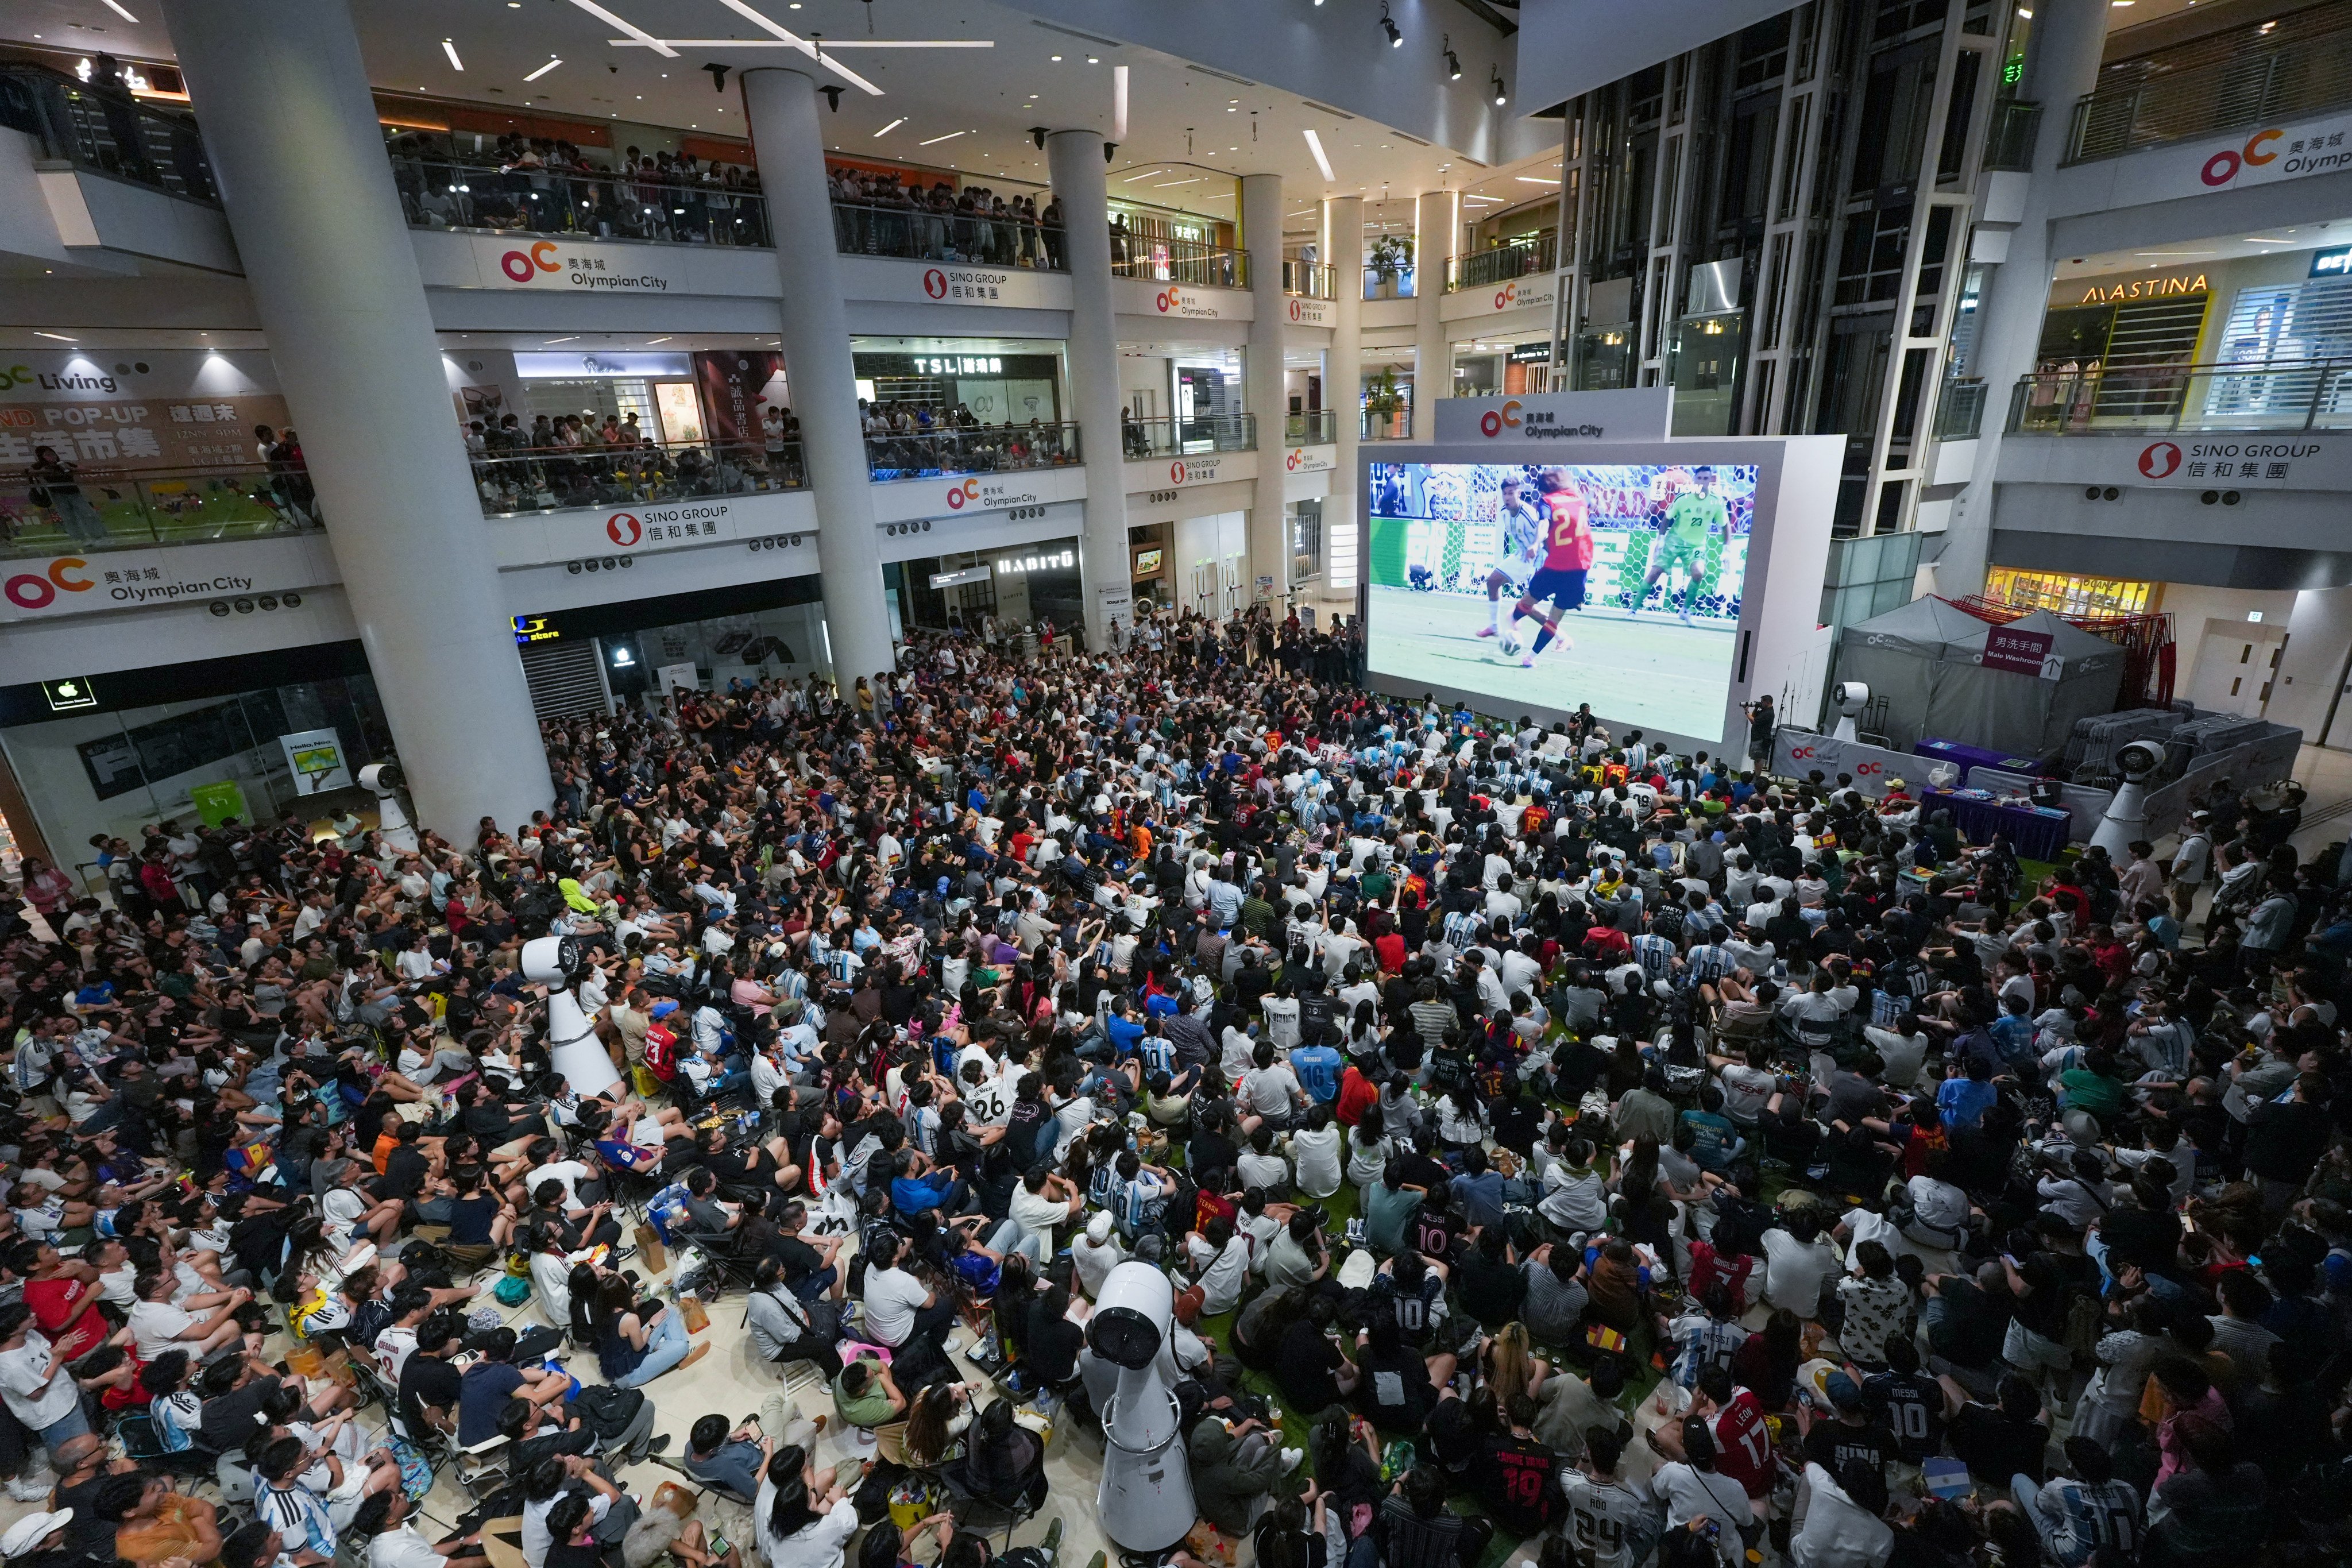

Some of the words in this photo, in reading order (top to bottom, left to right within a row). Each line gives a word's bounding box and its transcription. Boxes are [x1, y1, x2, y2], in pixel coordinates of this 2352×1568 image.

[2288, 132, 2345, 155] 奧海城
[2201, 129, 2284, 186] OC
[2284, 152, 2352, 173] Olymp
[501, 241, 562, 283] OC
[568, 258, 605, 271] 奧海城
[571, 273, 640, 289] Olympian
[641, 276, 667, 291] City
[950, 273, 972, 282] SINO
[975, 274, 1006, 284] GROUP
[952, 285, 998, 299] 信和集團
[1494, 283, 1515, 309] OC
[1517, 288, 1532, 296] 奧海城
[2083, 275, 2207, 302] MASTINA
[1157, 287, 1179, 312] OC
[1517, 296, 1543, 307] Olympian
[1543, 293, 1554, 303] City
[1182, 307, 1207, 316] Olympian
[1207, 308, 1218, 318] City
[1301, 312, 1322, 322] 信和集團
[914, 359, 956, 373] TSL
[38, 373, 117, 393] Living
[44, 407, 148, 426] POP-UP
[730, 384, 750, 438] 誠品書店
[1481, 400, 1522, 438] OC
[1525, 412, 1554, 424] 奧海城
[216, 428, 242, 437] 9PM
[1525, 425, 1578, 438] Olympian
[1579, 424, 1603, 438] City
[2191, 445, 2241, 457] SINO
[2245, 445, 2320, 457] GROUP
[1186, 461, 1200, 469] SINO
[1201, 459, 1221, 468] GROUP
[1287, 448, 1301, 471] OC
[1303, 462, 1319, 470] Olympian
[1187, 469, 1215, 481] 信和集團
[2188, 461, 2289, 478] 信和集團
[947, 478, 980, 509] OC
[983, 486, 1003, 495] 奧海城
[1674, 483, 1701, 495] now
[984, 495, 1021, 507] Olympian
[1022, 493, 1037, 504] City
[646, 511, 679, 523] SINO
[682, 507, 728, 519] GROUP
[1691, 517, 1702, 527] 23
[648, 521, 717, 540] 信和集團
[999, 551, 1072, 573] HABITŪ
[5, 558, 95, 609] OC
[105, 567, 161, 584] 奧海城
[111, 582, 211, 601] Olympian
[213, 576, 253, 592] City
[530, 631, 559, 641] store
[1867, 634, 1884, 645] OC
[1995, 636, 2043, 654] 男洗手間
[1987, 651, 2004, 659] Male
[2005, 653, 2043, 666] Washroom
[1266, 737, 1278, 751] 19
[1791, 746, 1816, 759] OC
[1611, 768, 1625, 783] 19
[1857, 762, 1882, 775] OC
[1180, 806, 1185, 816] 9
[1528, 816, 1540, 832] 19
[1930, 844, 1938, 860] 5
[1662, 905, 1682, 914] TOKYO
[1447, 927, 1463, 947] 10
[1642, 948, 1662, 970] 10
[829, 961, 843, 980] 10
[1702, 960, 1721, 979] 10
[1906, 964, 1920, 972] MESSI
[1906, 971, 1928, 997] 10
[1143, 1049, 1159, 1069] 10
[1303, 1065, 1324, 1087] 16
[973, 1086, 992, 1098] HEAVEN
[1485, 1078, 1503, 1096] 19
[1731, 1080, 1766, 1095] SCENE
[975, 1091, 1005, 1124] 26
[1687, 1121, 1724, 1134] TRAVELLING
[1114, 1179, 1128, 1194] MESSI
[1113, 1189, 1127, 1219] 10
[1198, 1198, 1219, 1214] FERRAN
[1422, 1212, 1445, 1223] MESSI
[1418, 1224, 1447, 1254] 10
[1713, 1256, 1739, 1272] RONALDO
[1716, 1270, 1732, 1286] 7
[64, 1279, 80, 1300] CHICAGO
[1393, 1296, 1423, 1331] 10
[1704, 1331, 1729, 1345] MESSI
[1697, 1344, 1735, 1373] 10
[1892, 1388, 1918, 1399] MESSI
[1736, 1407, 1754, 1427] LEON
[1887, 1401, 1928, 1438] 10
[1739, 1416, 1770, 1470] 17
[1496, 1451, 1524, 1467] LAMINE
[1525, 1454, 1550, 1469] YAMAL
[1502, 1467, 1542, 1508] 19
[2082, 1487, 2116, 1500] MESSI
[1574, 1508, 1620, 1553] 24
[2081, 1507, 2135, 1551] 10
